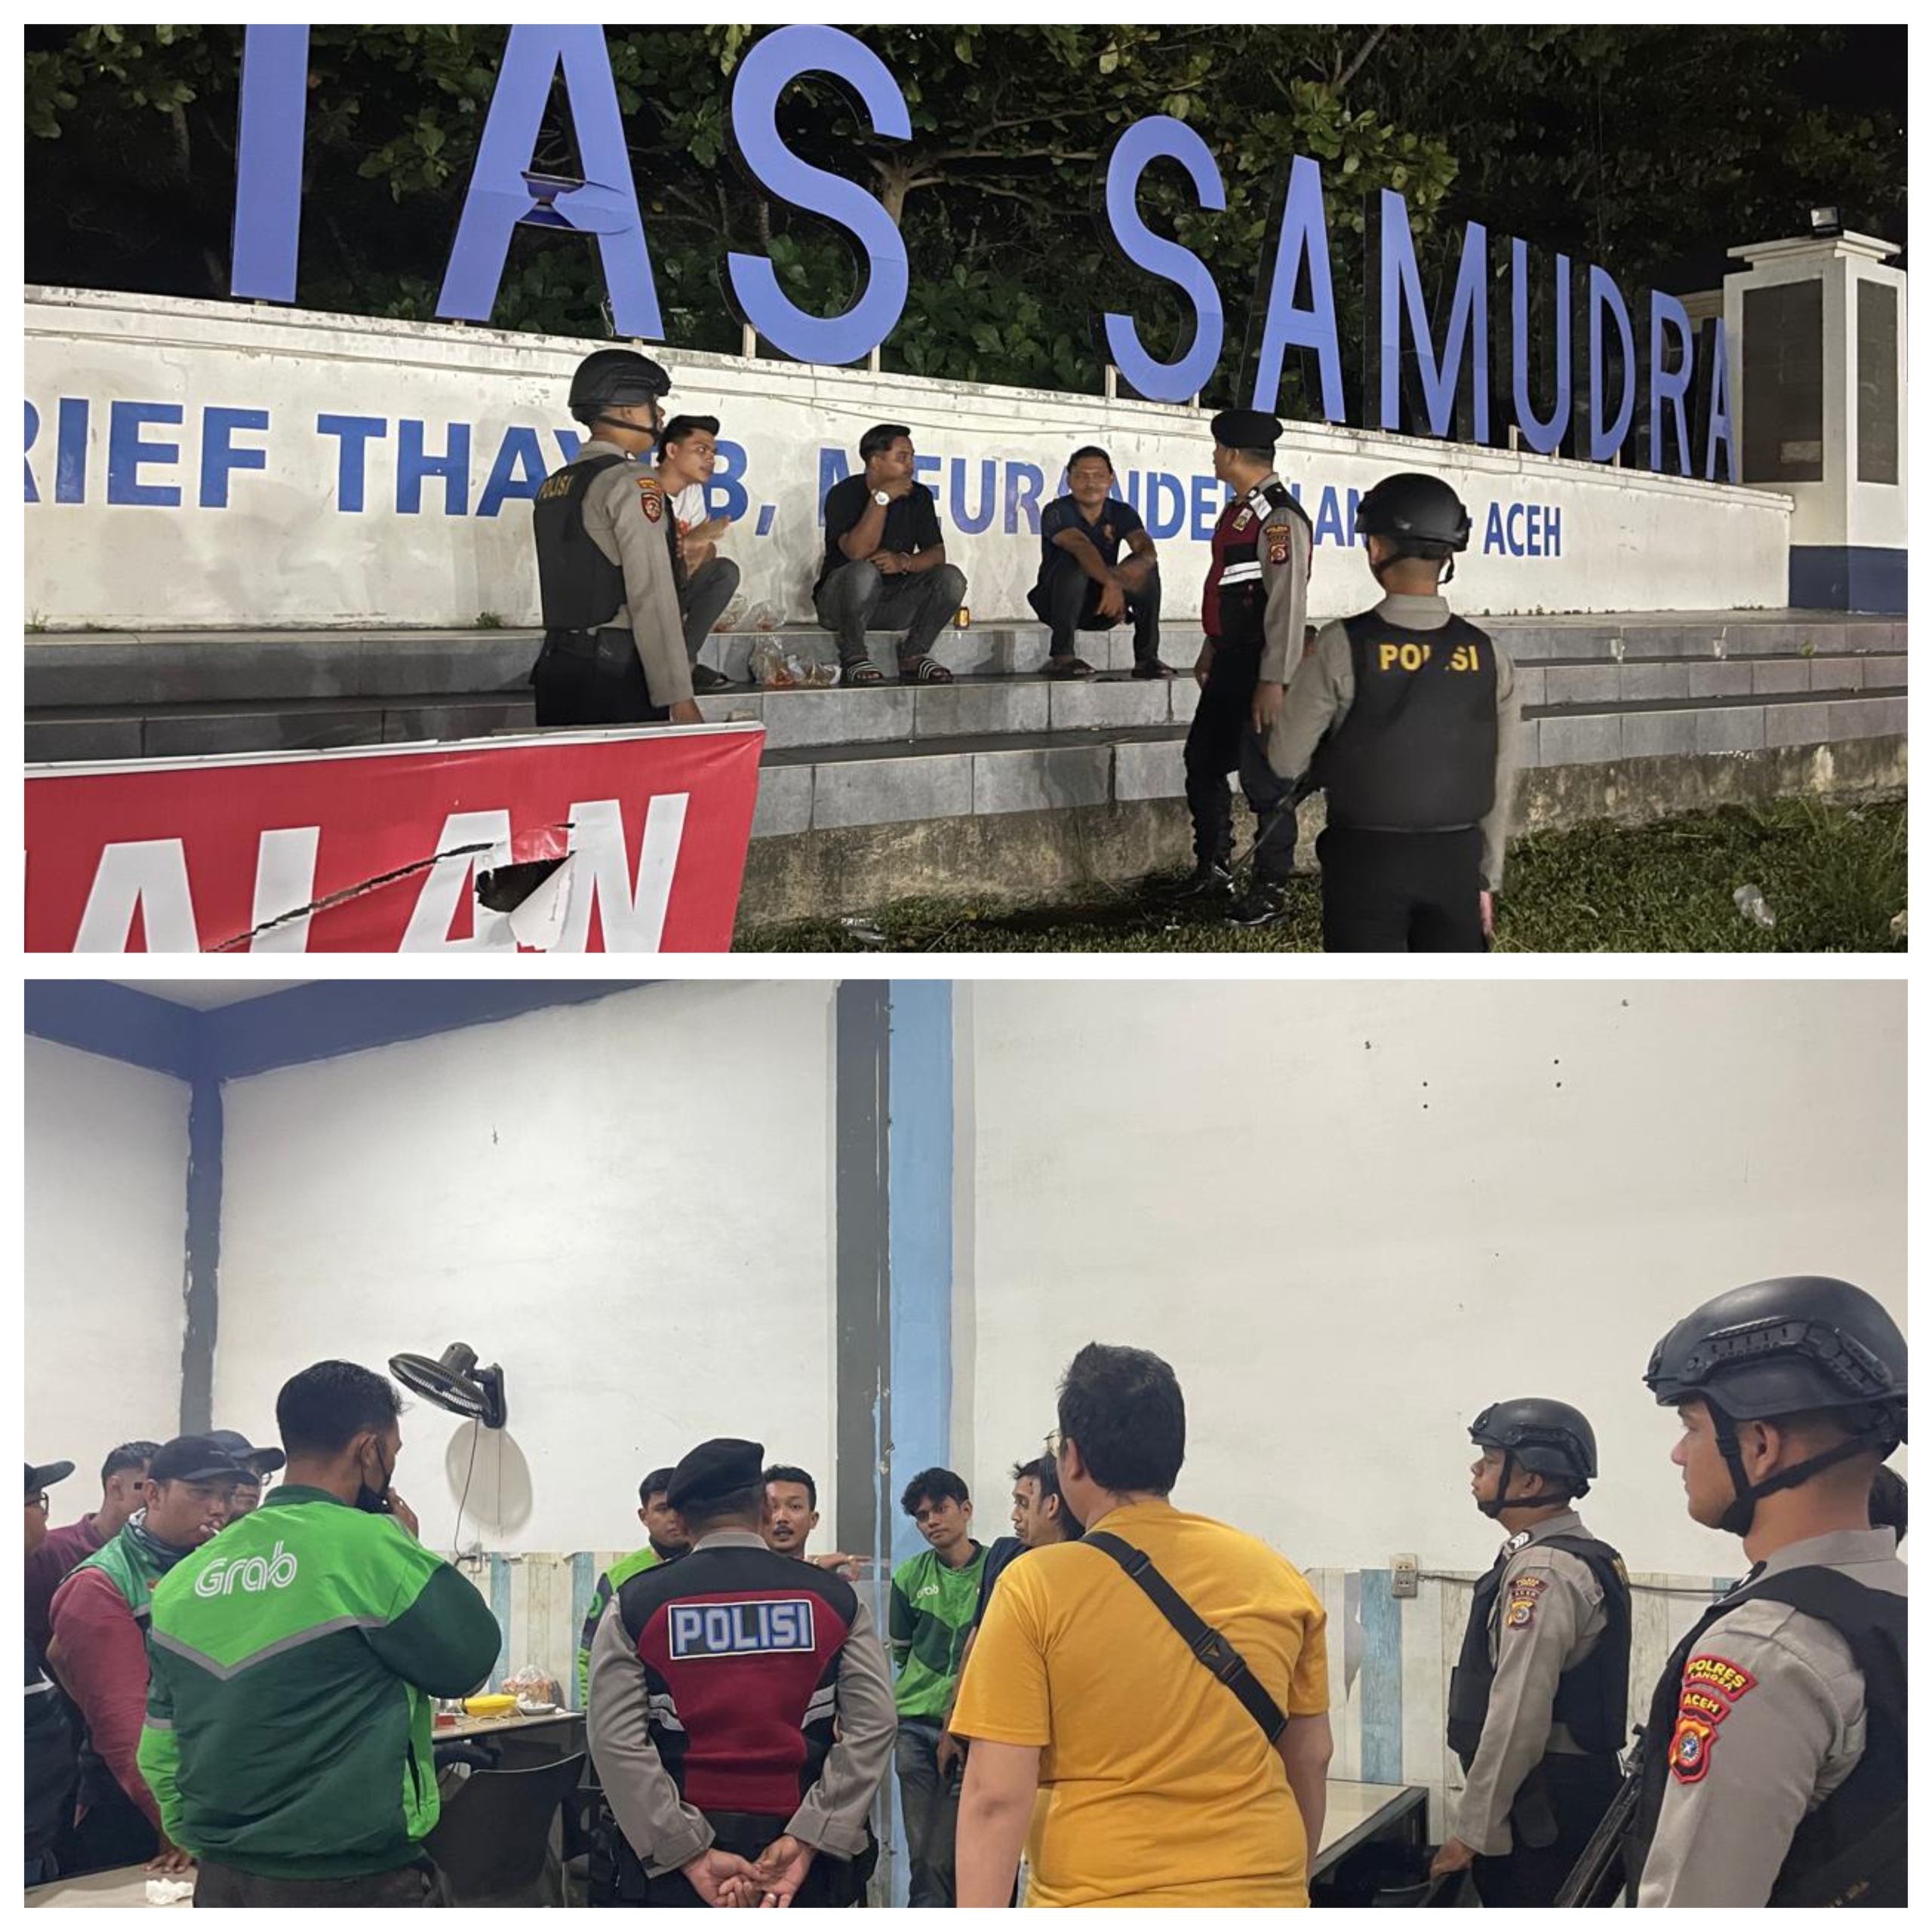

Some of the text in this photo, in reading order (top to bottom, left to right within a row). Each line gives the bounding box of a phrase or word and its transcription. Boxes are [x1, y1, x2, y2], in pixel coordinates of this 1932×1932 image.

[1104, 115, 1737, 485] SAMUDRA
[24, 397, 269, 509] IEF
[1483, 502, 1561, 557] ACEH
[1379, 643, 1479, 671] POSI
[195, 1540, 298, 1598] Grab
[674, 1604, 810, 1654] POLISI
[1687, 1660, 1747, 1688] POLRES
[1684, 1694, 1720, 1713] ACEH
